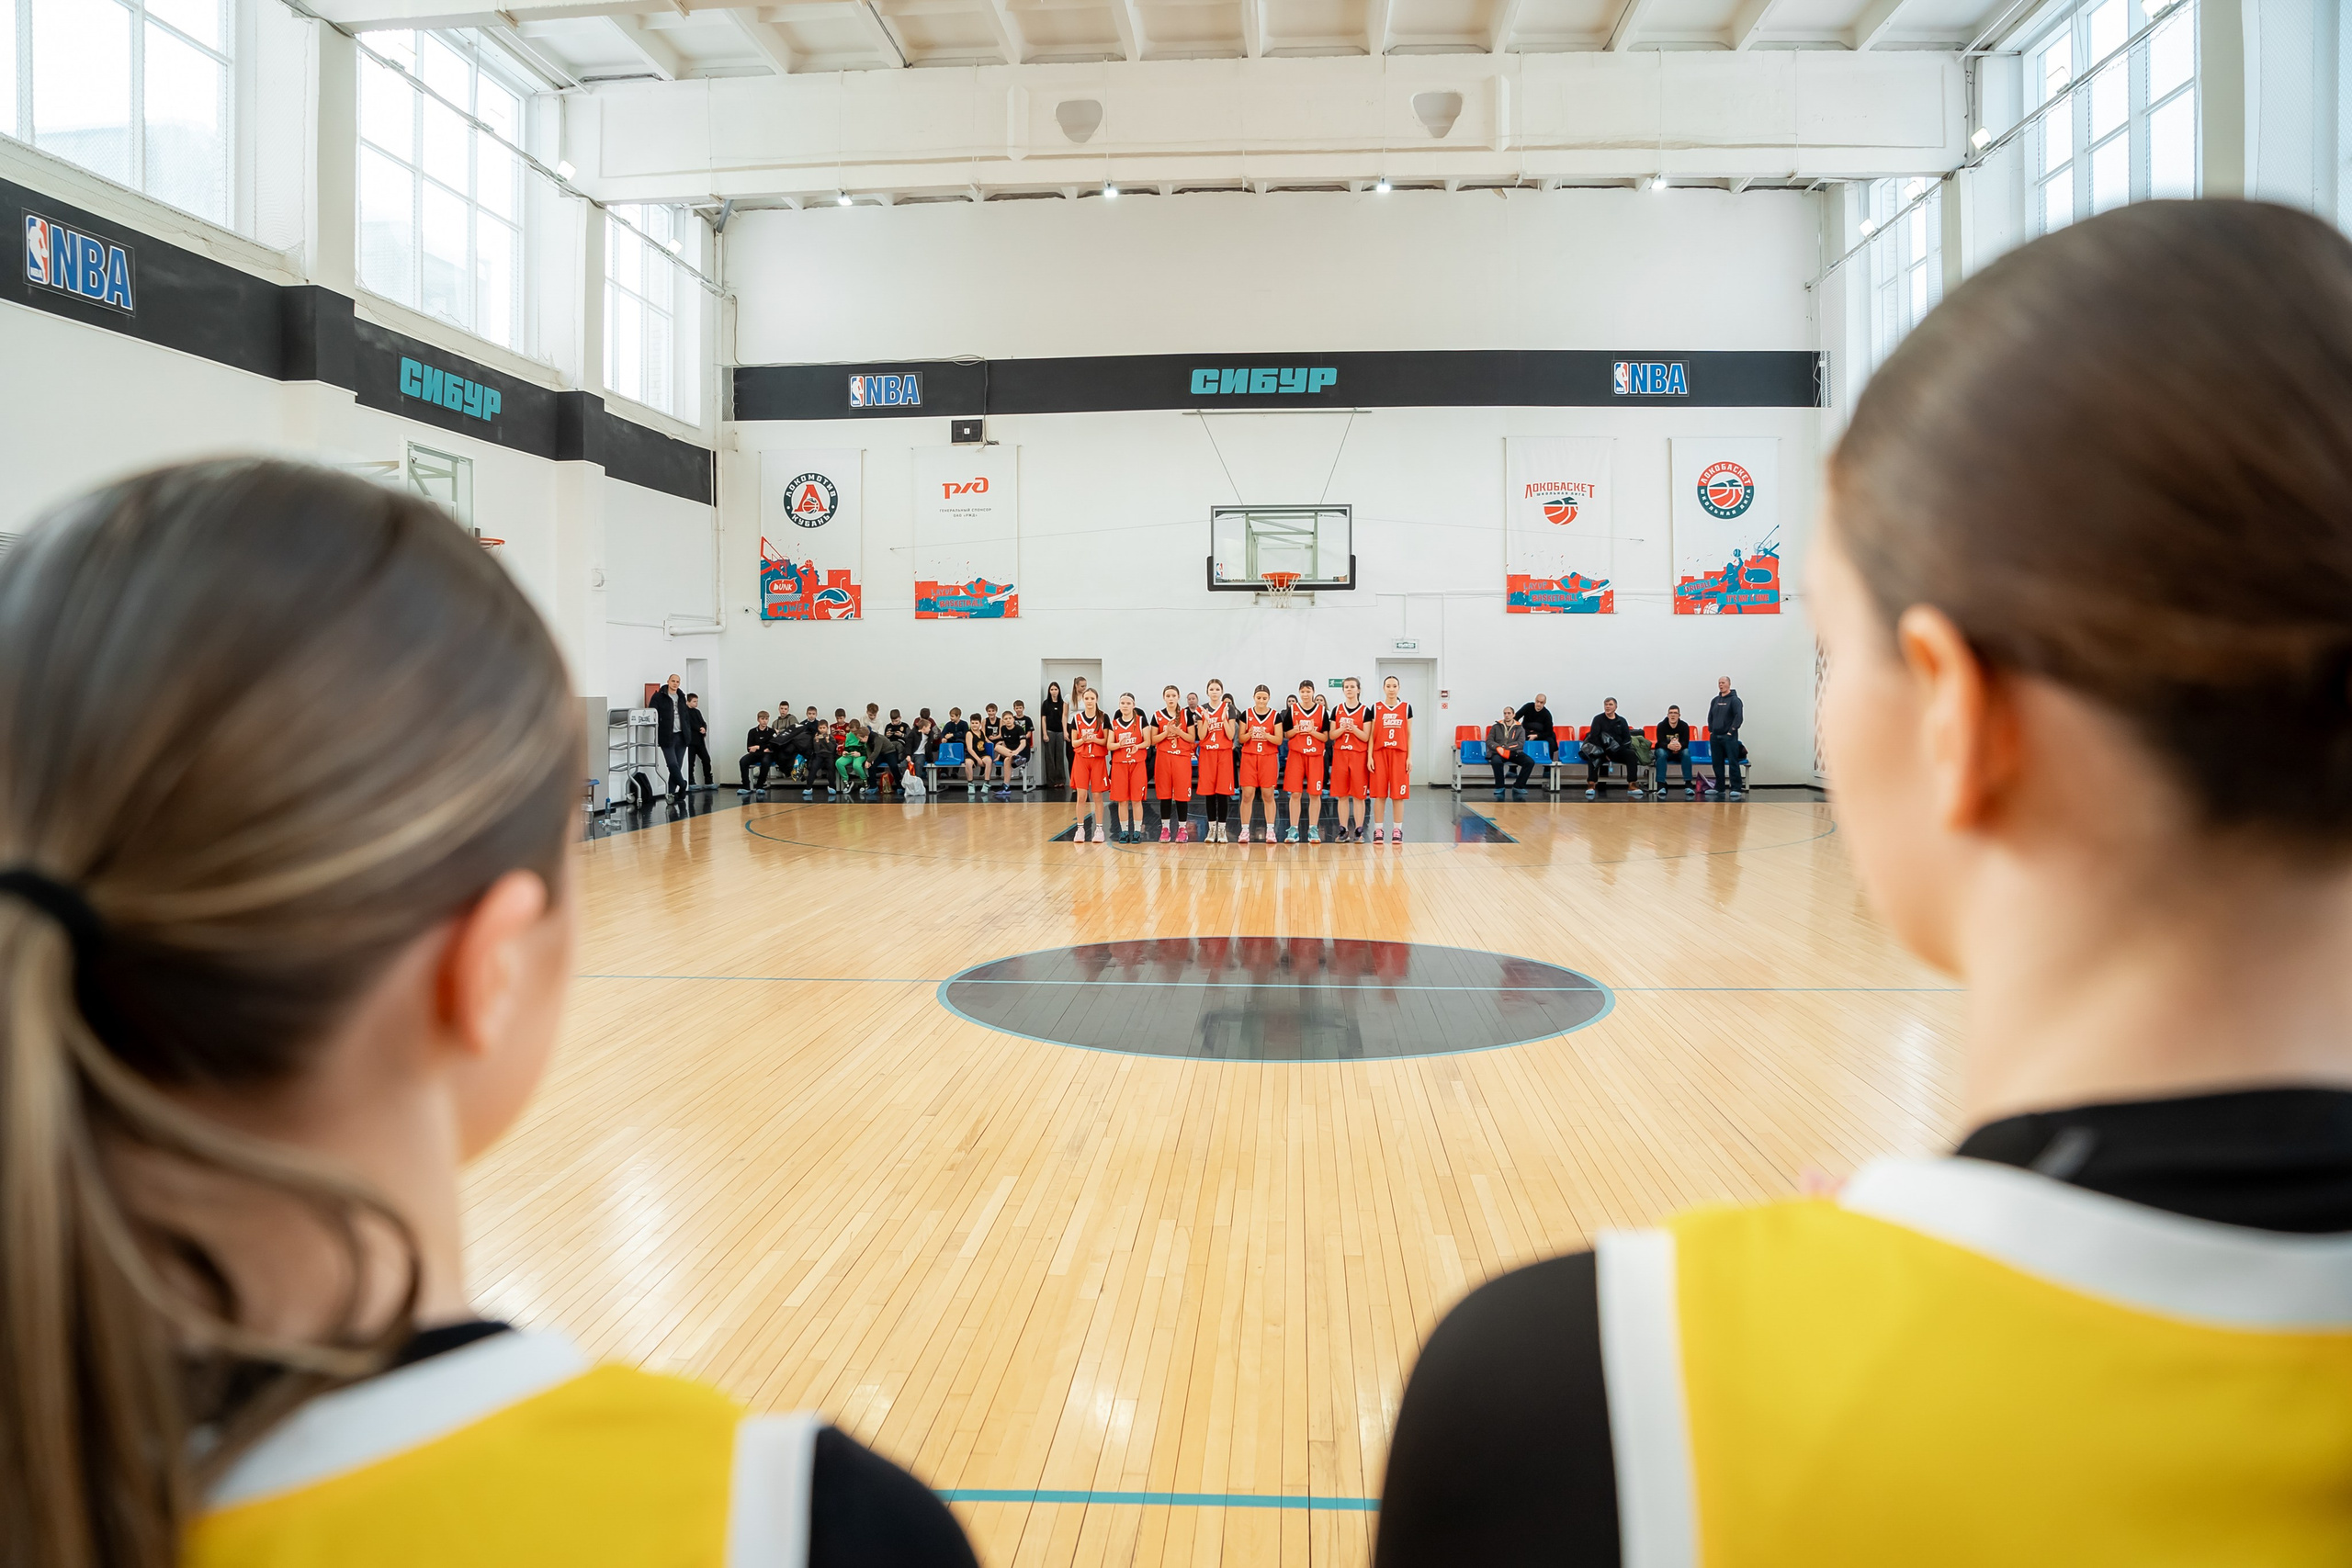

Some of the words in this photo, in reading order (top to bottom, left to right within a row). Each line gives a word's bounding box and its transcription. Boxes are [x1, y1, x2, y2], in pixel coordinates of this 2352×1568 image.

[50, 223, 133, 310] NBA
[1191, 367, 1338, 395] СИБУР
[1629, 363, 1688, 394] NBA
[400, 356, 502, 422] СИБУР
[865, 375, 921, 407] NBA
[1700, 463, 1752, 485] ЛОКОБАСКЕТ
[786, 473, 837, 498] ЛОКОМОТИВ
[1525, 482, 1596, 499] ЛОКОБАСКЕТ
[791, 513, 831, 527] КУБАНЬ
[773, 581, 793, 591] DUNK
[1532, 593, 1577, 603] BASKETBALL
[777, 603, 809, 614] POWER
[939, 599, 984, 608] BASKETBALL
[1210, 732, 1216, 742] 4
[1344, 733, 1350, 743] 7
[1388, 728, 1395, 739] 8
[1171, 739, 1176, 749] 3
[1306, 736, 1312, 746] 6
[1088, 744, 1091, 753] 1
[1257, 742, 1262, 752] 5
[1125, 748, 1132, 758] 2
[1102, 776, 1108, 786] 1
[1316, 781, 1321, 791] 6
[1187, 787, 1192, 797] 3
[1400, 784, 1407, 795] 8
